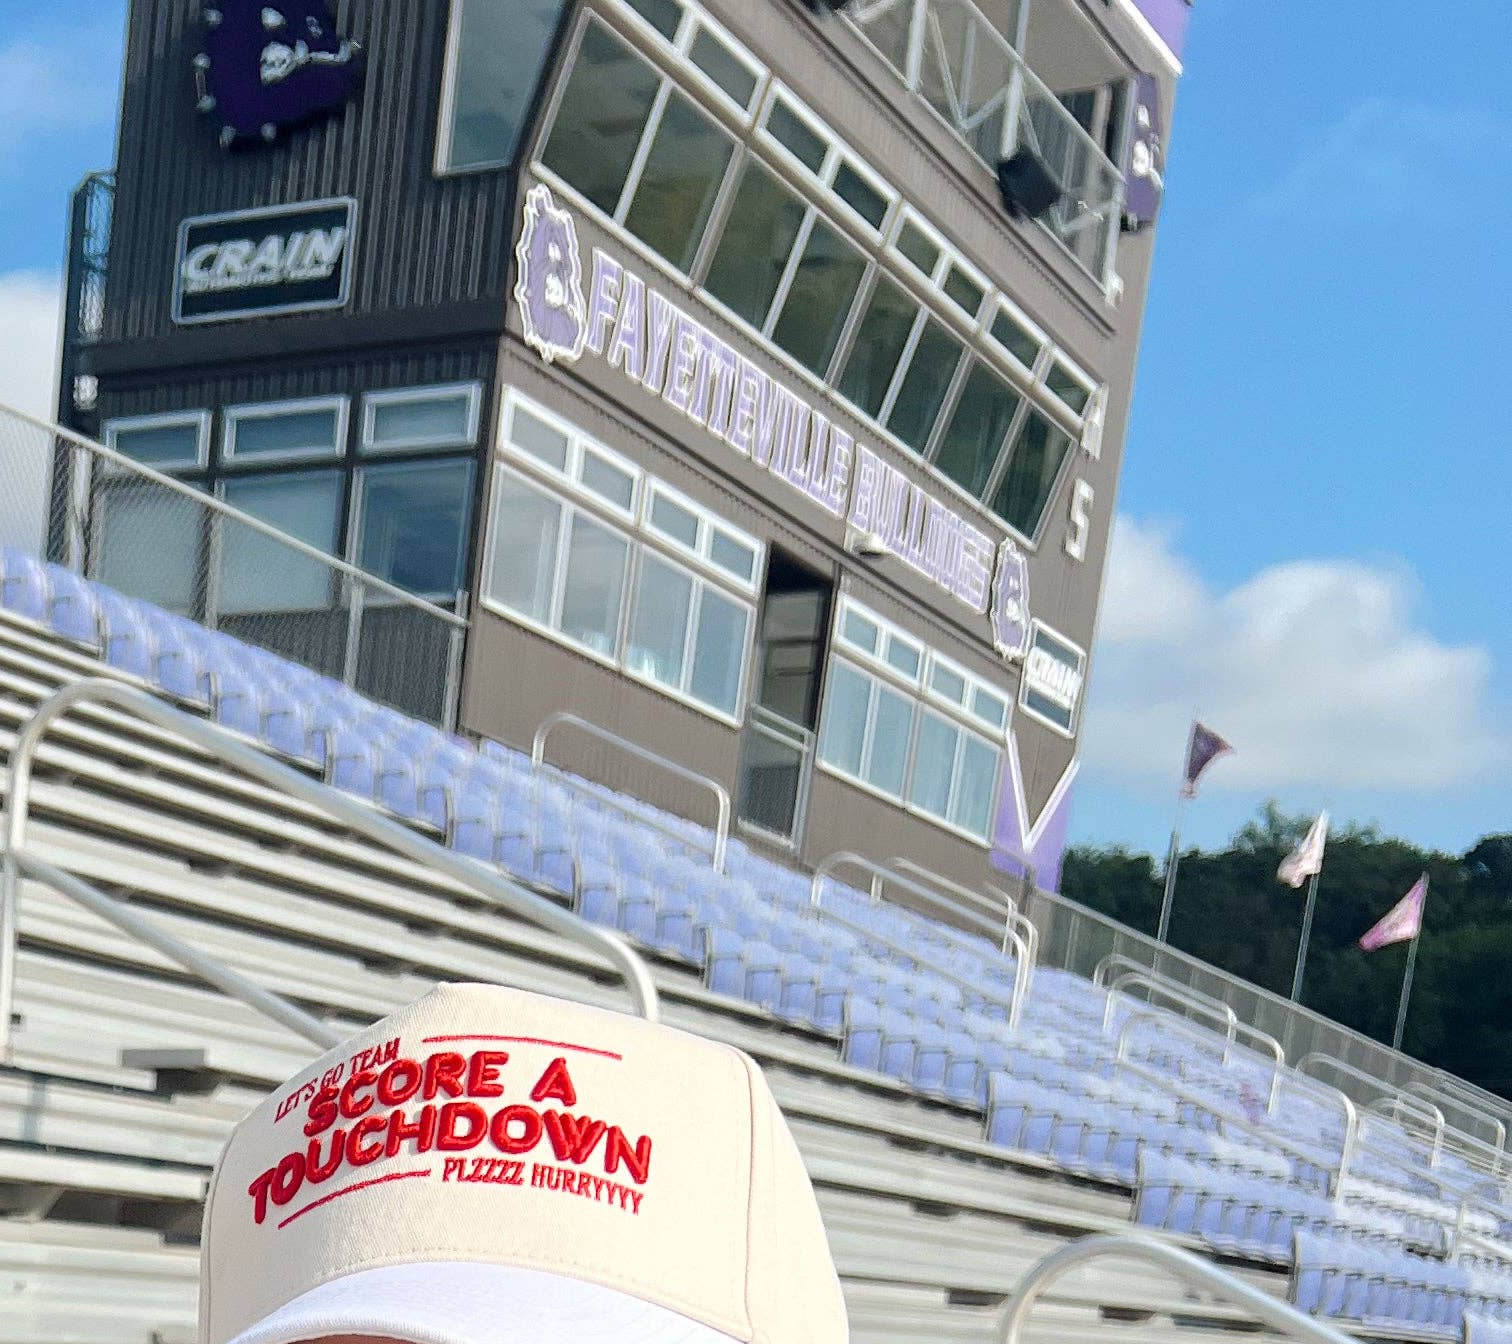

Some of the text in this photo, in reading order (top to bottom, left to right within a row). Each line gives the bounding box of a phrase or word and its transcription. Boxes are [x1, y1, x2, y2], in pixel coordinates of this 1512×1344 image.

[182, 226, 346, 279] CRAIN
[586, 246, 854, 519] FAYETTEVILLE
[274, 1036, 401, 1124] LET'S GO TEAM
[303, 1050, 578, 1138] SCORE A
[248, 1100, 652, 1224] TOUCHDOWN
